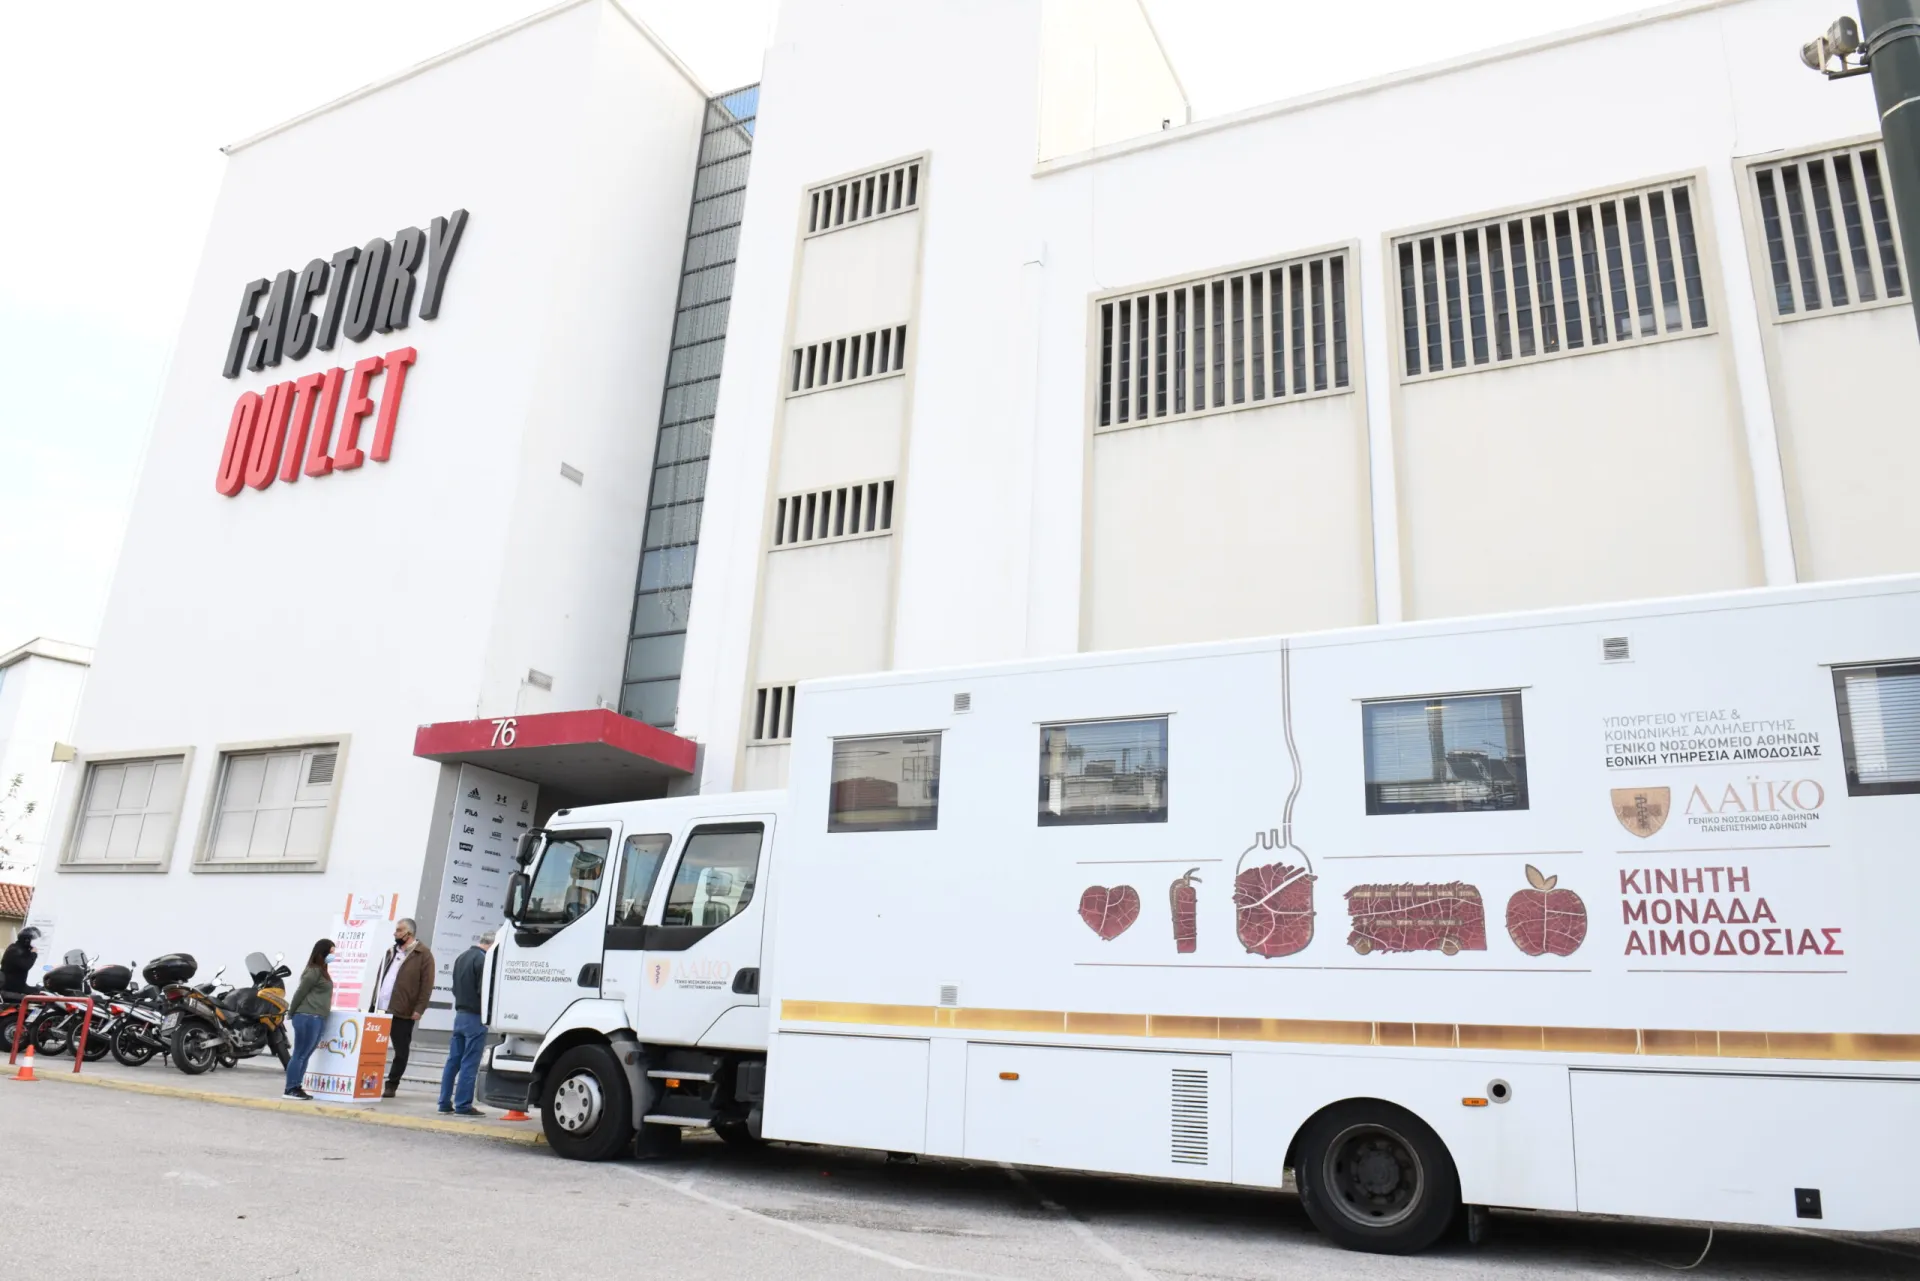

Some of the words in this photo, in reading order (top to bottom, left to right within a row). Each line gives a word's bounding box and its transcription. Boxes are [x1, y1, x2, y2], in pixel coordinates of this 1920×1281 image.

[222, 208, 470, 379] FACTORY
[216, 346, 417, 497] OUTLET
[1603, 713, 1676, 728] ΥΠΟΥΡΓΕΙΟ
[1680, 710, 1727, 723] ΥΓΕΙΑΣ
[1731, 709, 1741, 720] &
[491, 718, 517, 747] 76
[1604, 725, 1690, 741] ΚΟΙΝΩΝΙΚΗΣ
[1693, 719, 1796, 736] ΑΛΛΗΛΕΓΓΥΗΣ
[1606, 742, 1656, 754] ΓΕΝΙΚΟ
[1660, 736, 1752, 752] ΝΟΣΟΚΟΜΕΙΟ
[1757, 732, 1820, 746] ΑΘΗΝΩΝ
[1605, 754, 1657, 767] ΕΘΝΙΚΗ
[1661, 750, 1730, 764] ΥΠΗΡΕΣΙΑ
[1733, 745, 1822, 760] ΑΙΜΟΔΟΣΙΑΣ
[1685, 775, 1825, 815] ΛΑΪΚΟ
[465, 808, 478, 817] FILA
[1688, 815, 1720, 824] ΓΕΝΙΚΟ
[1722, 814, 1779, 824] ΝΟΣΟΚΟΜΕΙΟ
[1781, 813, 1819, 822] ΑΘΗΝΩΝ
[463, 824, 474, 835] Lee
[1701, 823, 1767, 833] ΠΑΝΕΠΙΣΤΗΜΙΟ
[1769, 821, 1807, 831] ΑΘΗΝΩΝ
[1620, 866, 1751, 895] ΚΙΝΗΤΗ
[450, 894, 464, 904] BSB
[1622, 897, 1777, 925] ΜΟΝΑΔΑ
[335, 941, 364, 949] OUTLET
[337, 932, 366, 940] FACTORY
[1624, 928, 1845, 956] ΑΙΜΟΔΟΣΙΑΣ
